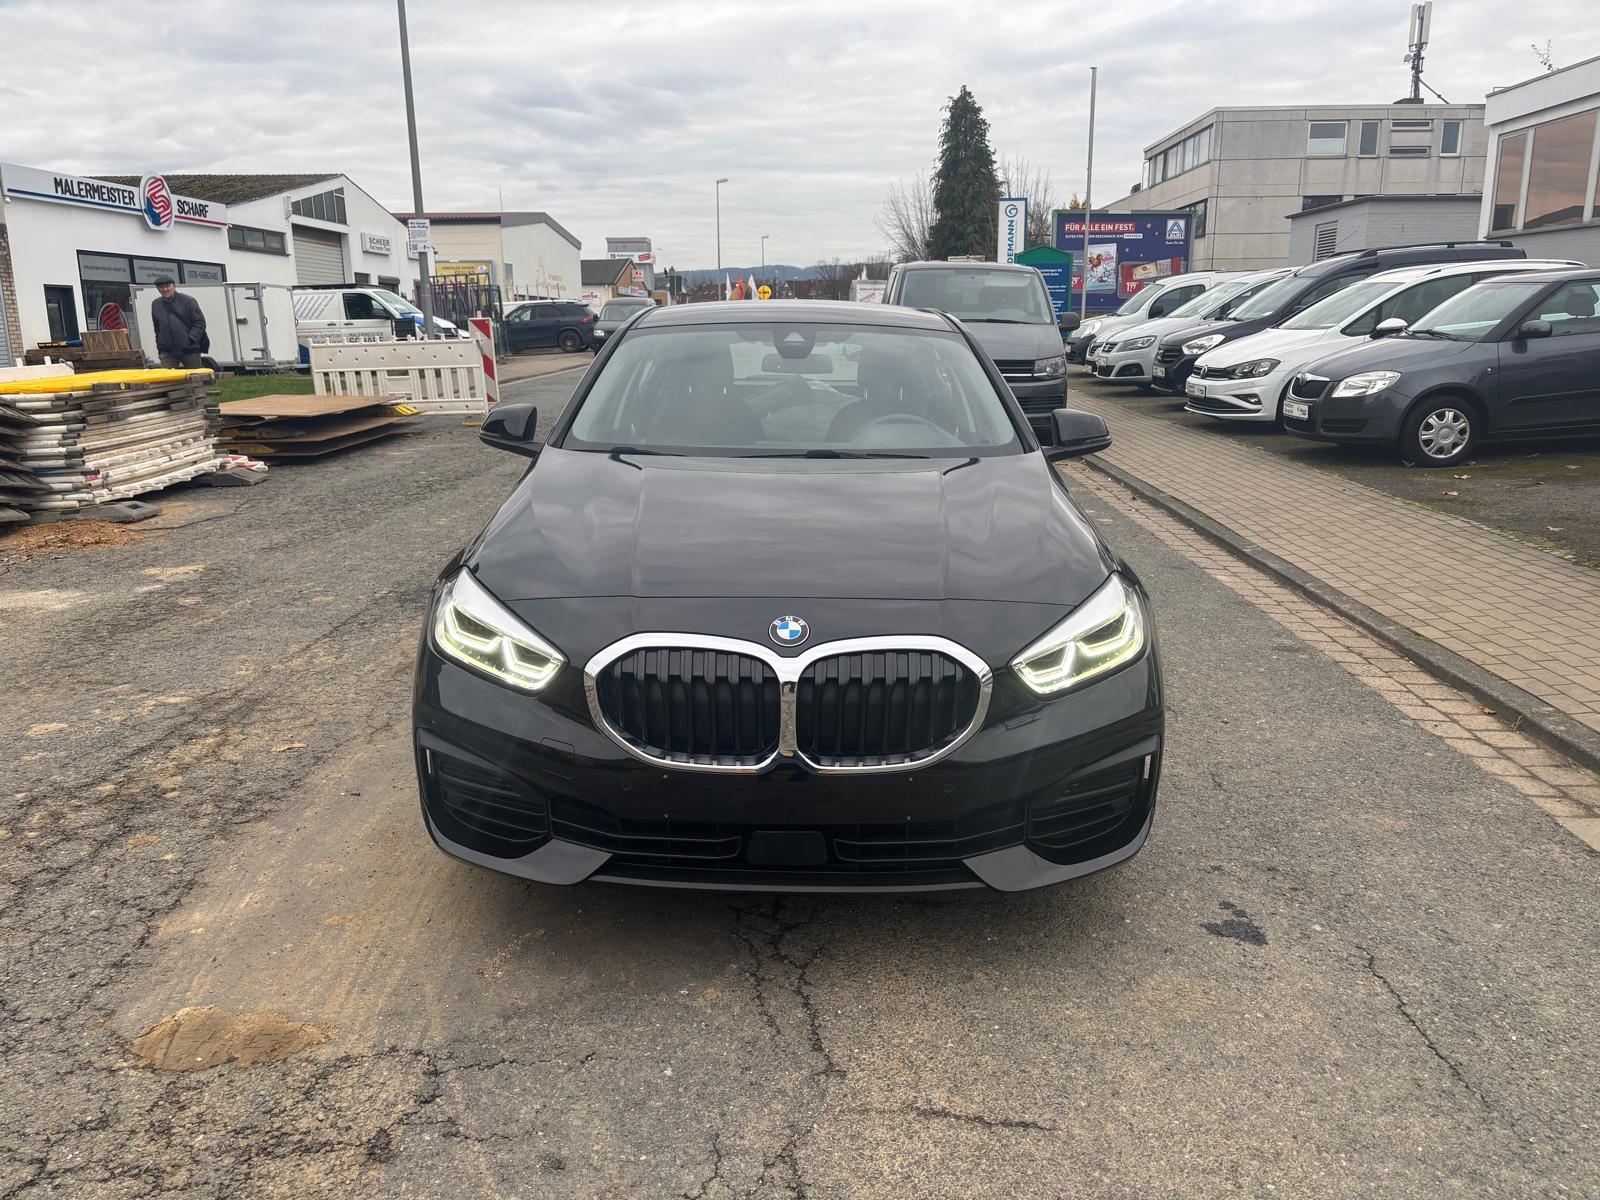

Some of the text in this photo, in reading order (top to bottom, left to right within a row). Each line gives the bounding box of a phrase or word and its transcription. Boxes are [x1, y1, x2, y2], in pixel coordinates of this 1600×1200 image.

[53, 176, 209, 218] MALERMEISTER SCHARF
[1065, 223, 1135, 231] FÜR ALE EIN FEST.
[773, 616, 806, 625] BMW
